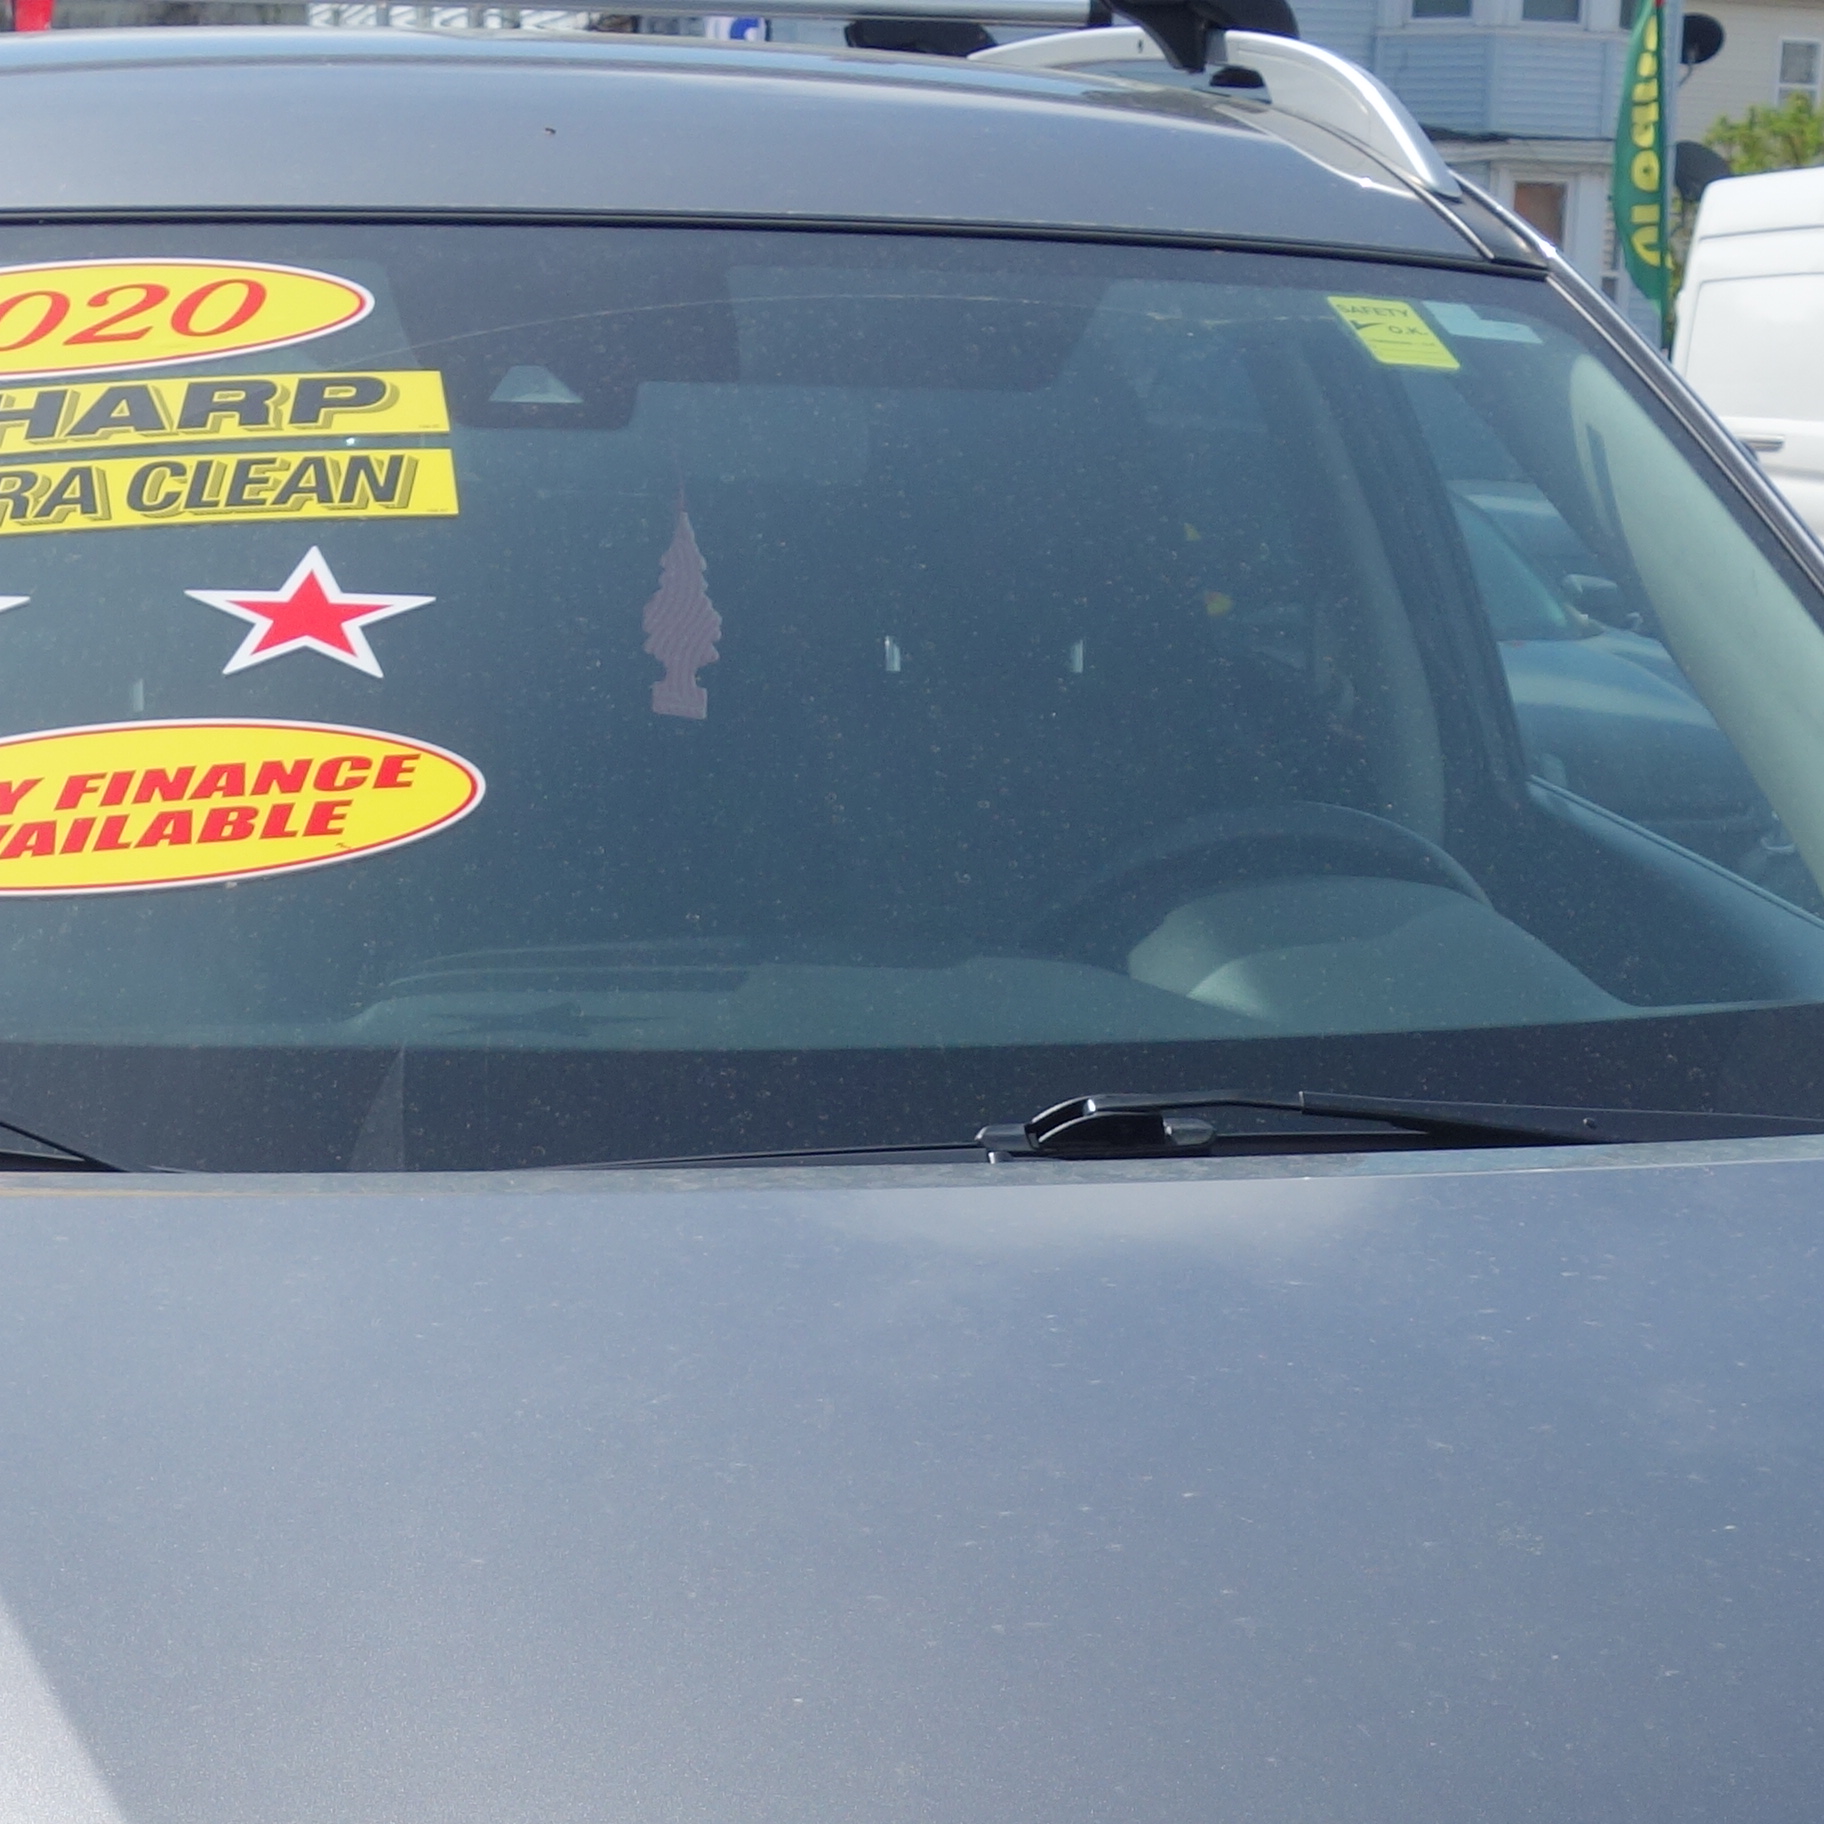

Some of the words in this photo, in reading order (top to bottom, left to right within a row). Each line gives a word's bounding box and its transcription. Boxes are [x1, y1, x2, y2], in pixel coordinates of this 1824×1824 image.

[1336, 304, 1409, 317] SAFETY
[126, 454, 419, 516] CLEAN
[54, 753, 422, 811] FINANCE
